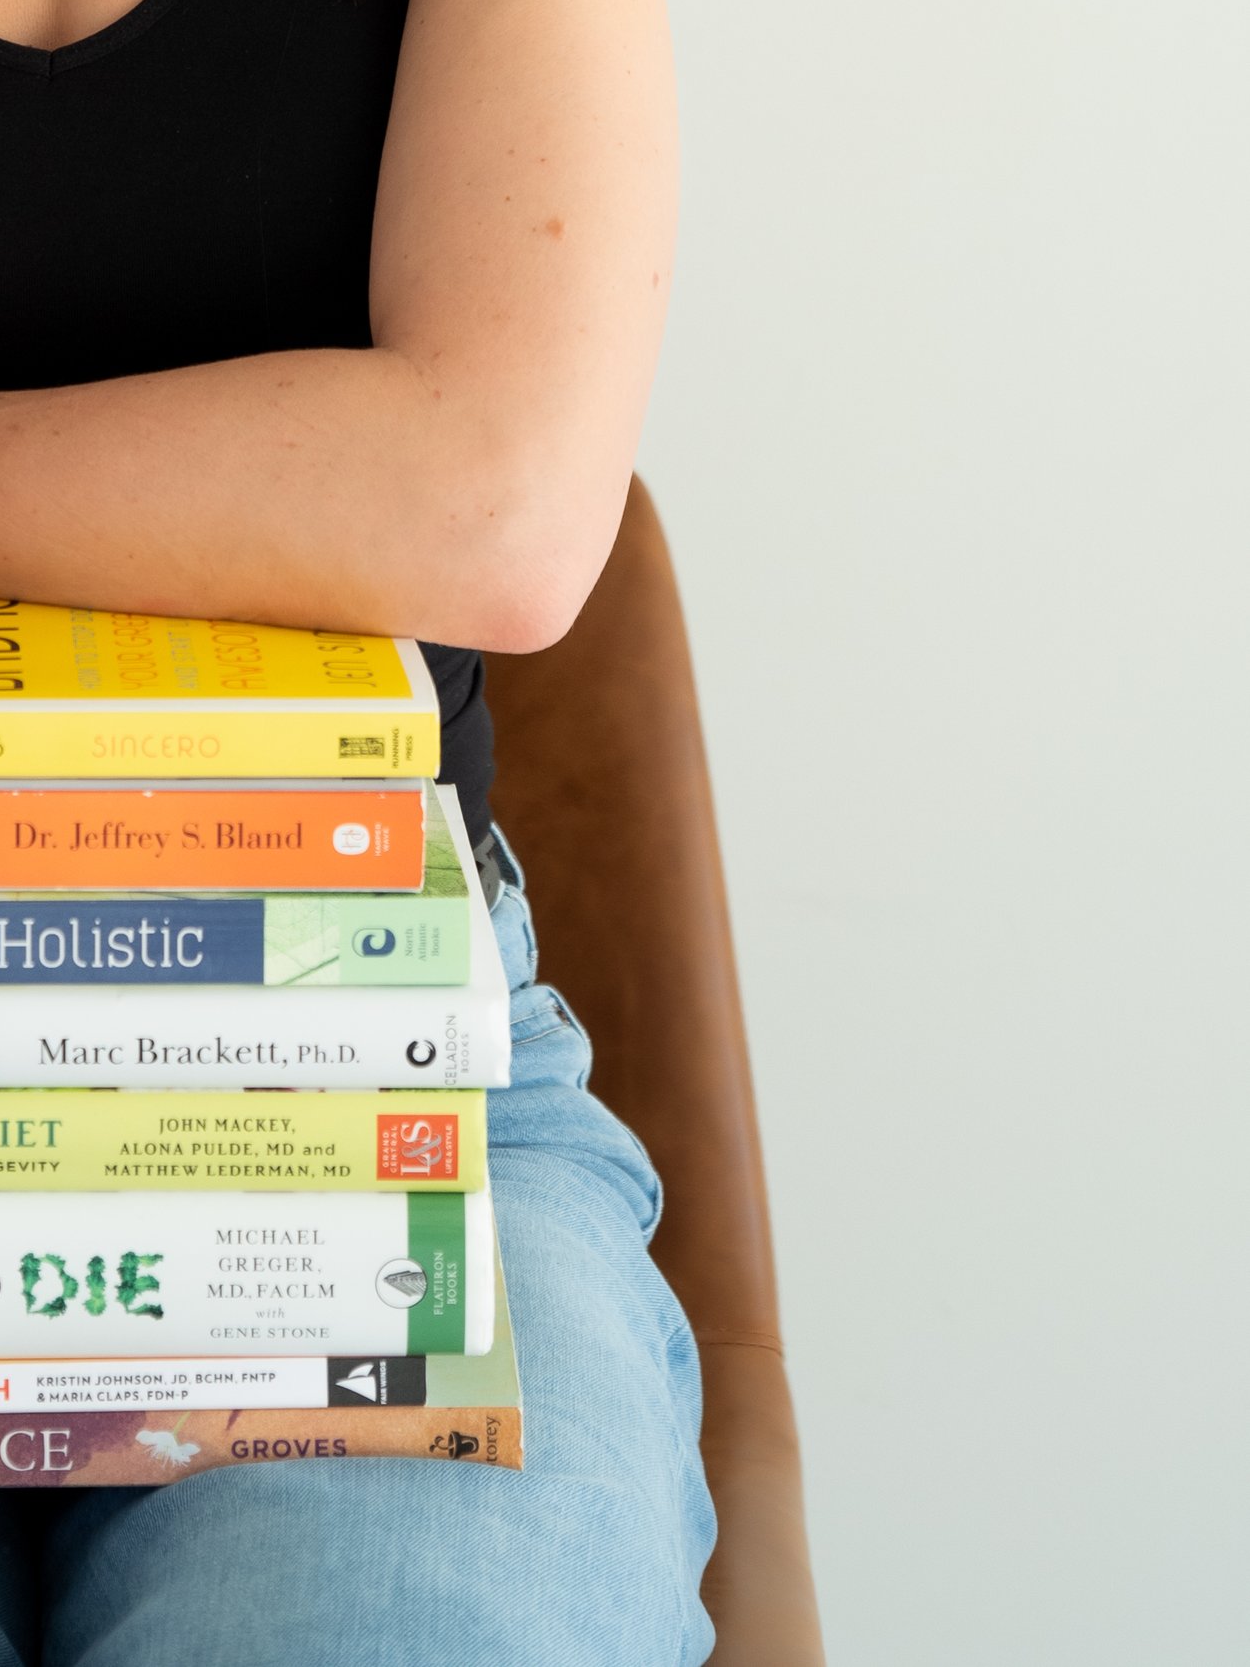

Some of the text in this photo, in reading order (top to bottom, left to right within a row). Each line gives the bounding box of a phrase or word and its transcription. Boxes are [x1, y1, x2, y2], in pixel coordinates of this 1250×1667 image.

[117, 652, 159, 691] YOUR
[91, 735, 221, 759] SINCERO
[12, 821, 304, 858] Dr. Jeffrey S. Bland
[404, 928, 414, 957] North
[417, 922, 427, 962] Atlantic
[431, 927, 440, 957] Books
[38, 1037, 361, 1069] Marc Brackett, Ph.D.
[444, 1014, 457, 1086] CELADON
[460, 1032, 469, 1074] BOOKS
[158, 1118, 297, 1134] JOHN MACKEY,
[445, 1124, 453, 1151] STYLE
[119, 1143, 336, 1158] ALONA PULDE, MD and
[382, 1131, 390, 1168] GRAND
[390, 1125, 398, 1173] CENTRAL
[104, 1165, 352, 1178] MATTHEW LEDERMAN, MD
[445, 1158, 453, 1175] LIFE
[215, 1229, 326, 1246] MICHAEL
[218, 1256, 322, 1273] GREGER,
[18, 1250, 166, 1319] DIE
[256, 1283, 336, 1299] FACLM
[433, 1251, 444, 1316] FLATIRON
[446, 1262, 458, 1305] BOOKS
[255, 1307, 286, 1319] with
[209, 1327, 330, 1340] GENE STONE
[36, 1372, 277, 1387] KRISTIN JOHNSON, JD, BCHN, FNTP
[36, 1390, 189, 1403] & MARIA CLAPS, FDN-P
[380, 1387, 388, 1405] FAIR
[230, 1438, 348, 1459] GROVES
[485, 1415, 502, 1466] torey
